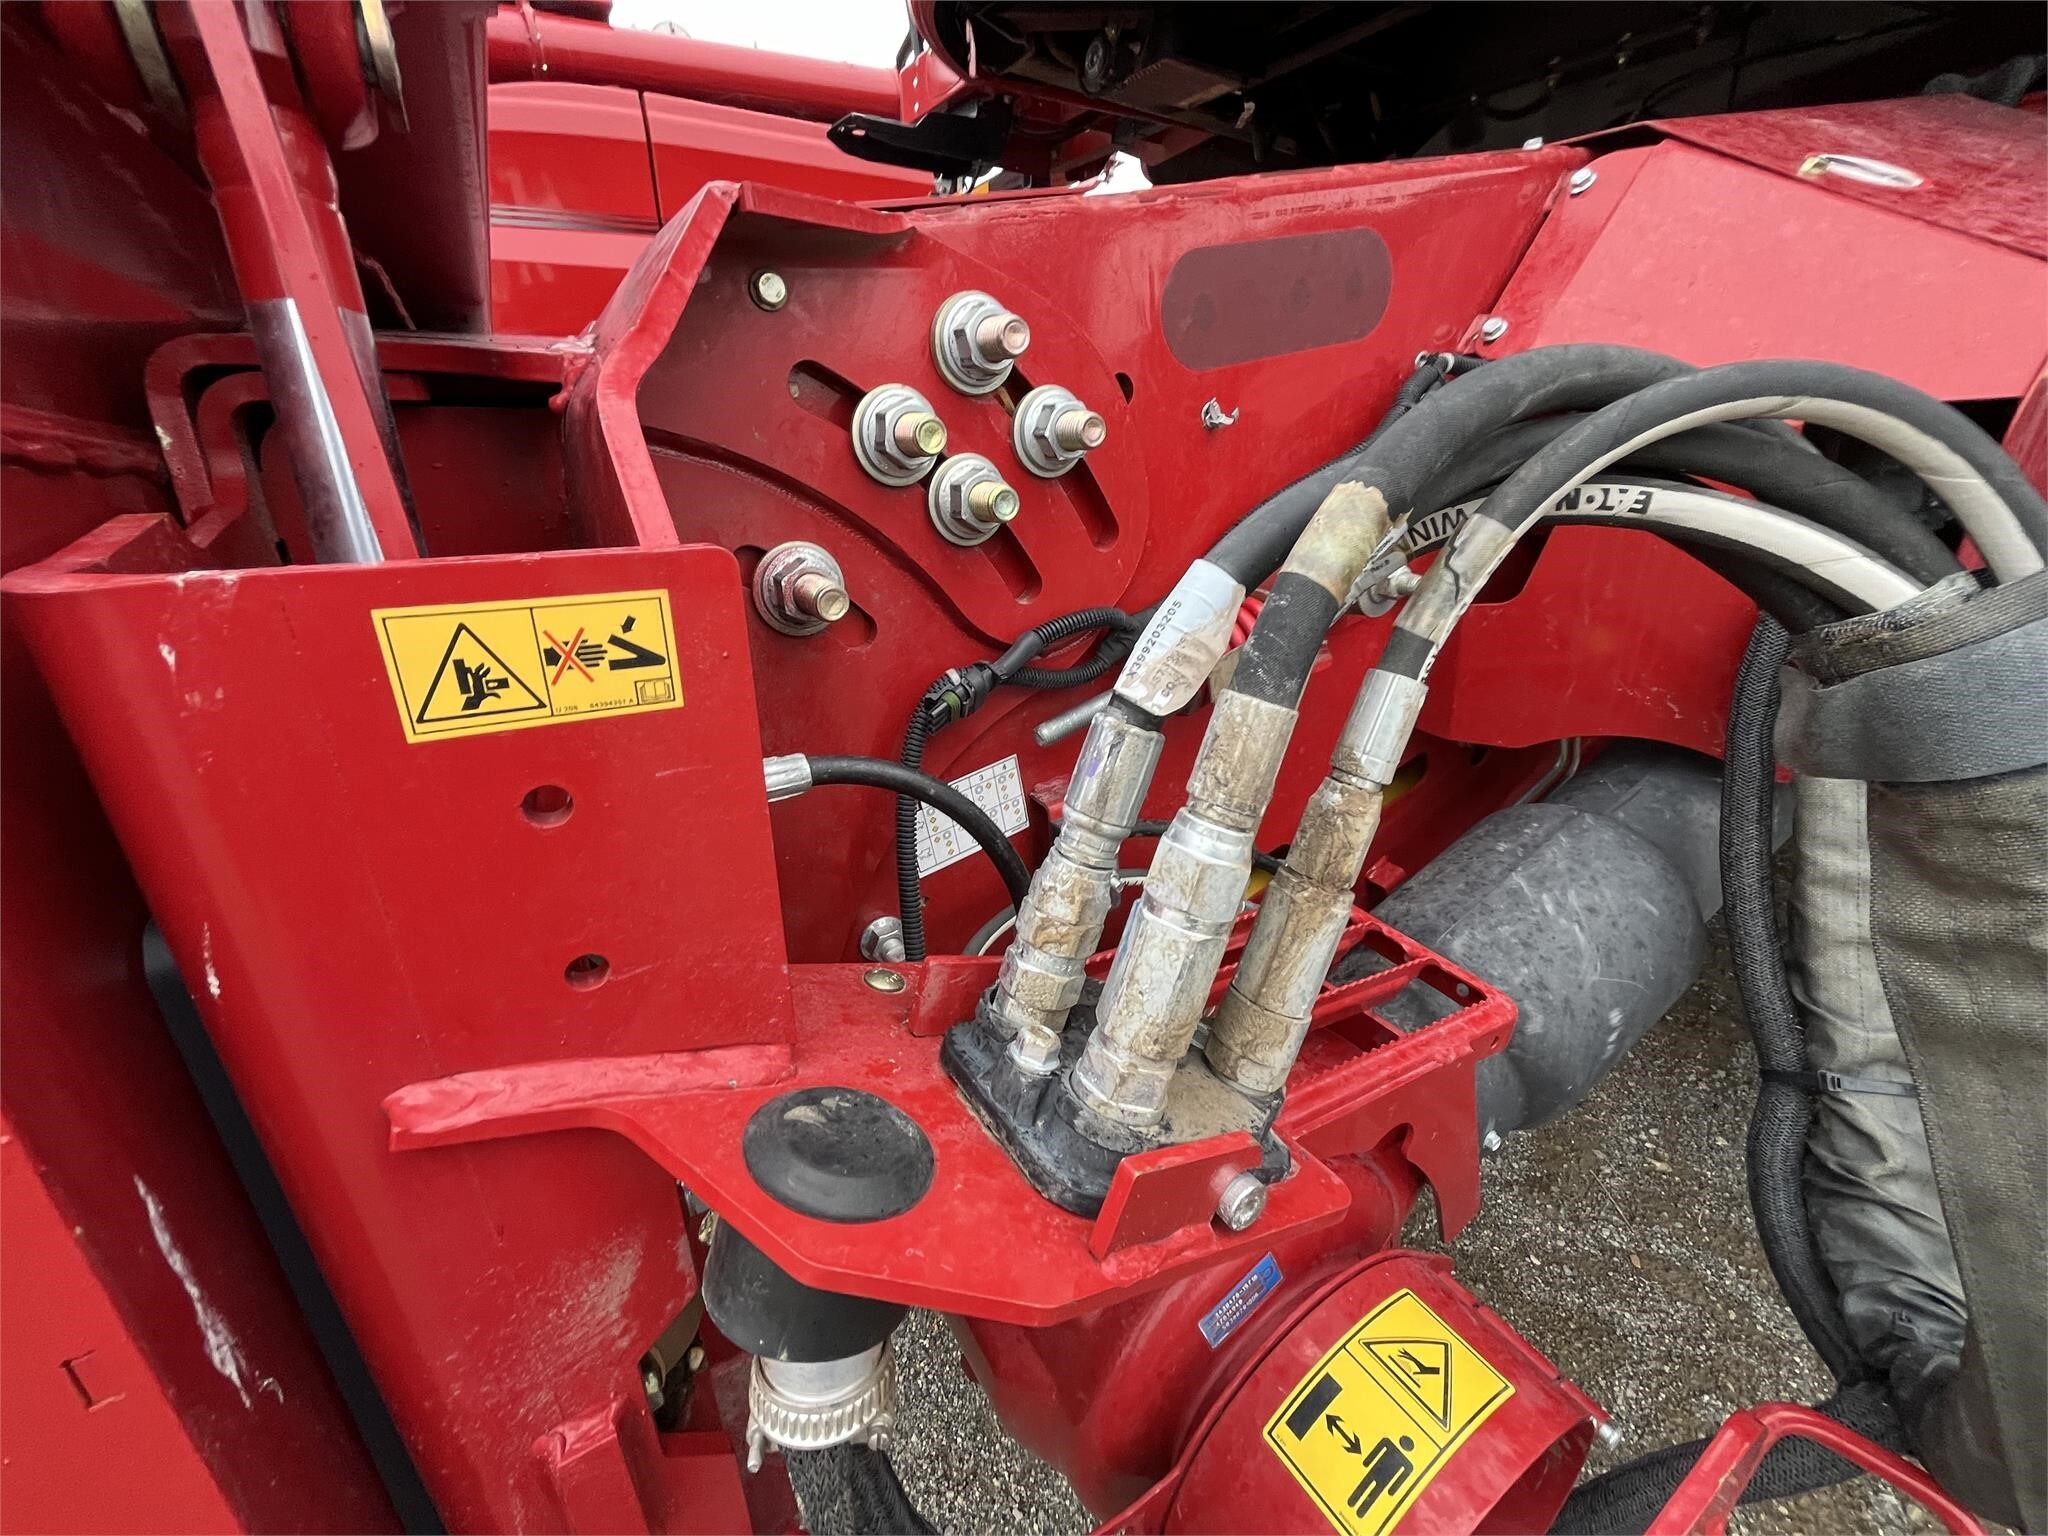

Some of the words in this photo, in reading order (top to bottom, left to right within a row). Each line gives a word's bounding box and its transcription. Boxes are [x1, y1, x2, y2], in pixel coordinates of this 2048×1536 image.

[1554, 487, 1655, 515] EATON
[1406, 507, 1469, 547] WIN
[1126, 599, 1183, 679] X399203205
